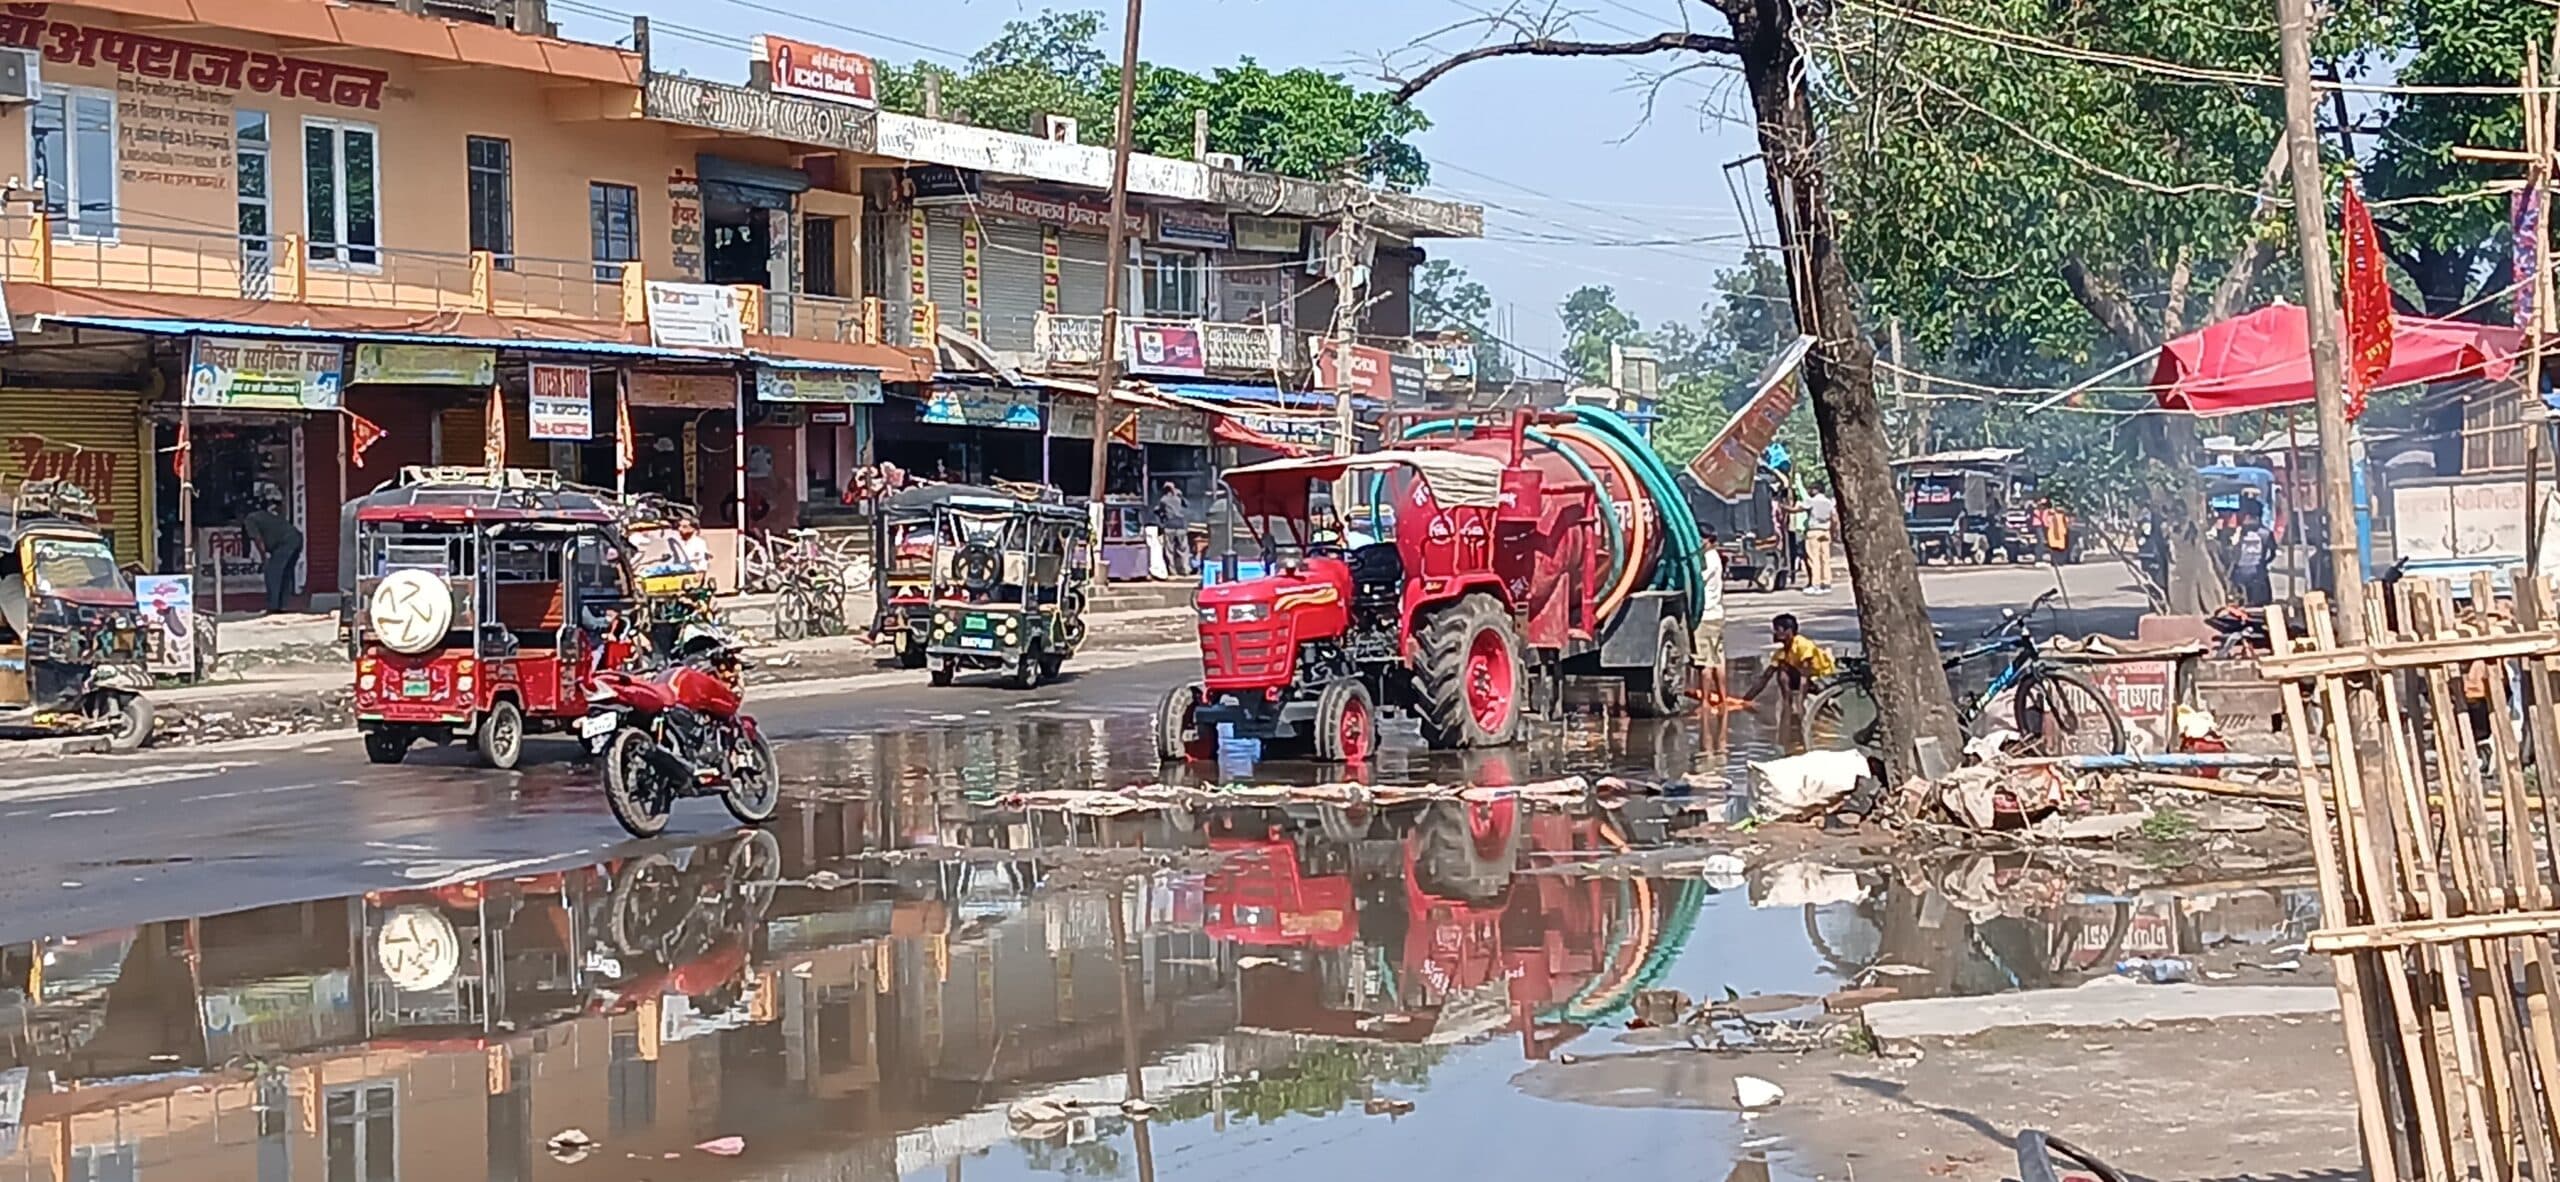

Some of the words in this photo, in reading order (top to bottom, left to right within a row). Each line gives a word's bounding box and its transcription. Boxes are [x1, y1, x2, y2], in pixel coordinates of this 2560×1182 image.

[794, 67, 824, 88] ICICI
[825, 73, 856, 94] Bank
[672, 200, 698, 225] हेयर
[2116, 675, 2165, 713] वैष्णव
